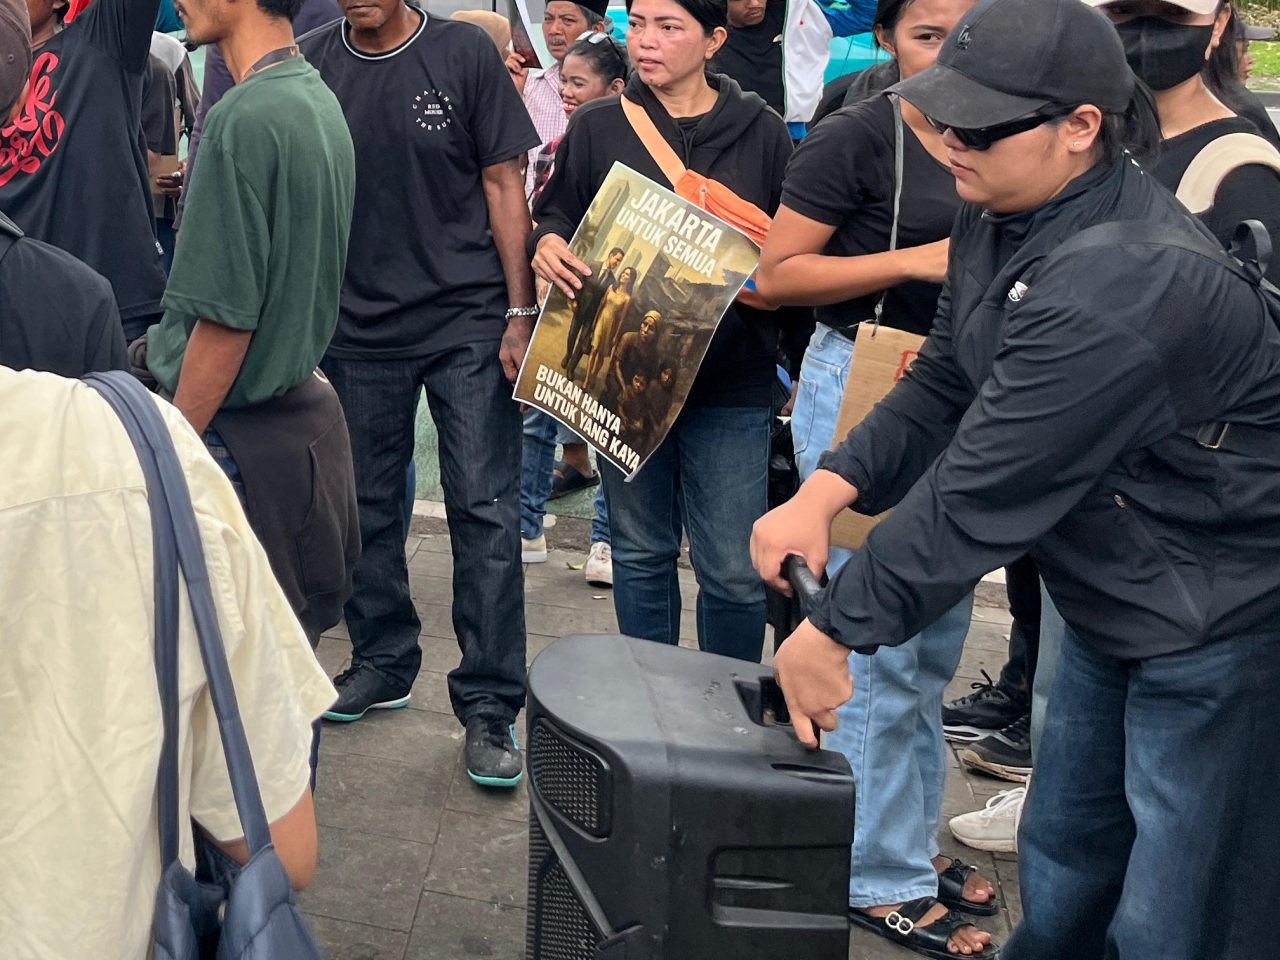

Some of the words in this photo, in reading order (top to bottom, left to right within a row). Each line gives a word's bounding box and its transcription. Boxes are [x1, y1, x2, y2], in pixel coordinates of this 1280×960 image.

[615, 207, 667, 249] UNTUK
[663, 235, 717, 278] SEMUA
[630, 188, 723, 253] JAKARTA
[533, 383, 579, 424] UNTUK
[579, 411, 610, 448] YANG
[608, 439, 641, 472] KAYA
[535, 364, 583, 404] BUKAN
[580, 393, 621, 435] HANYA
